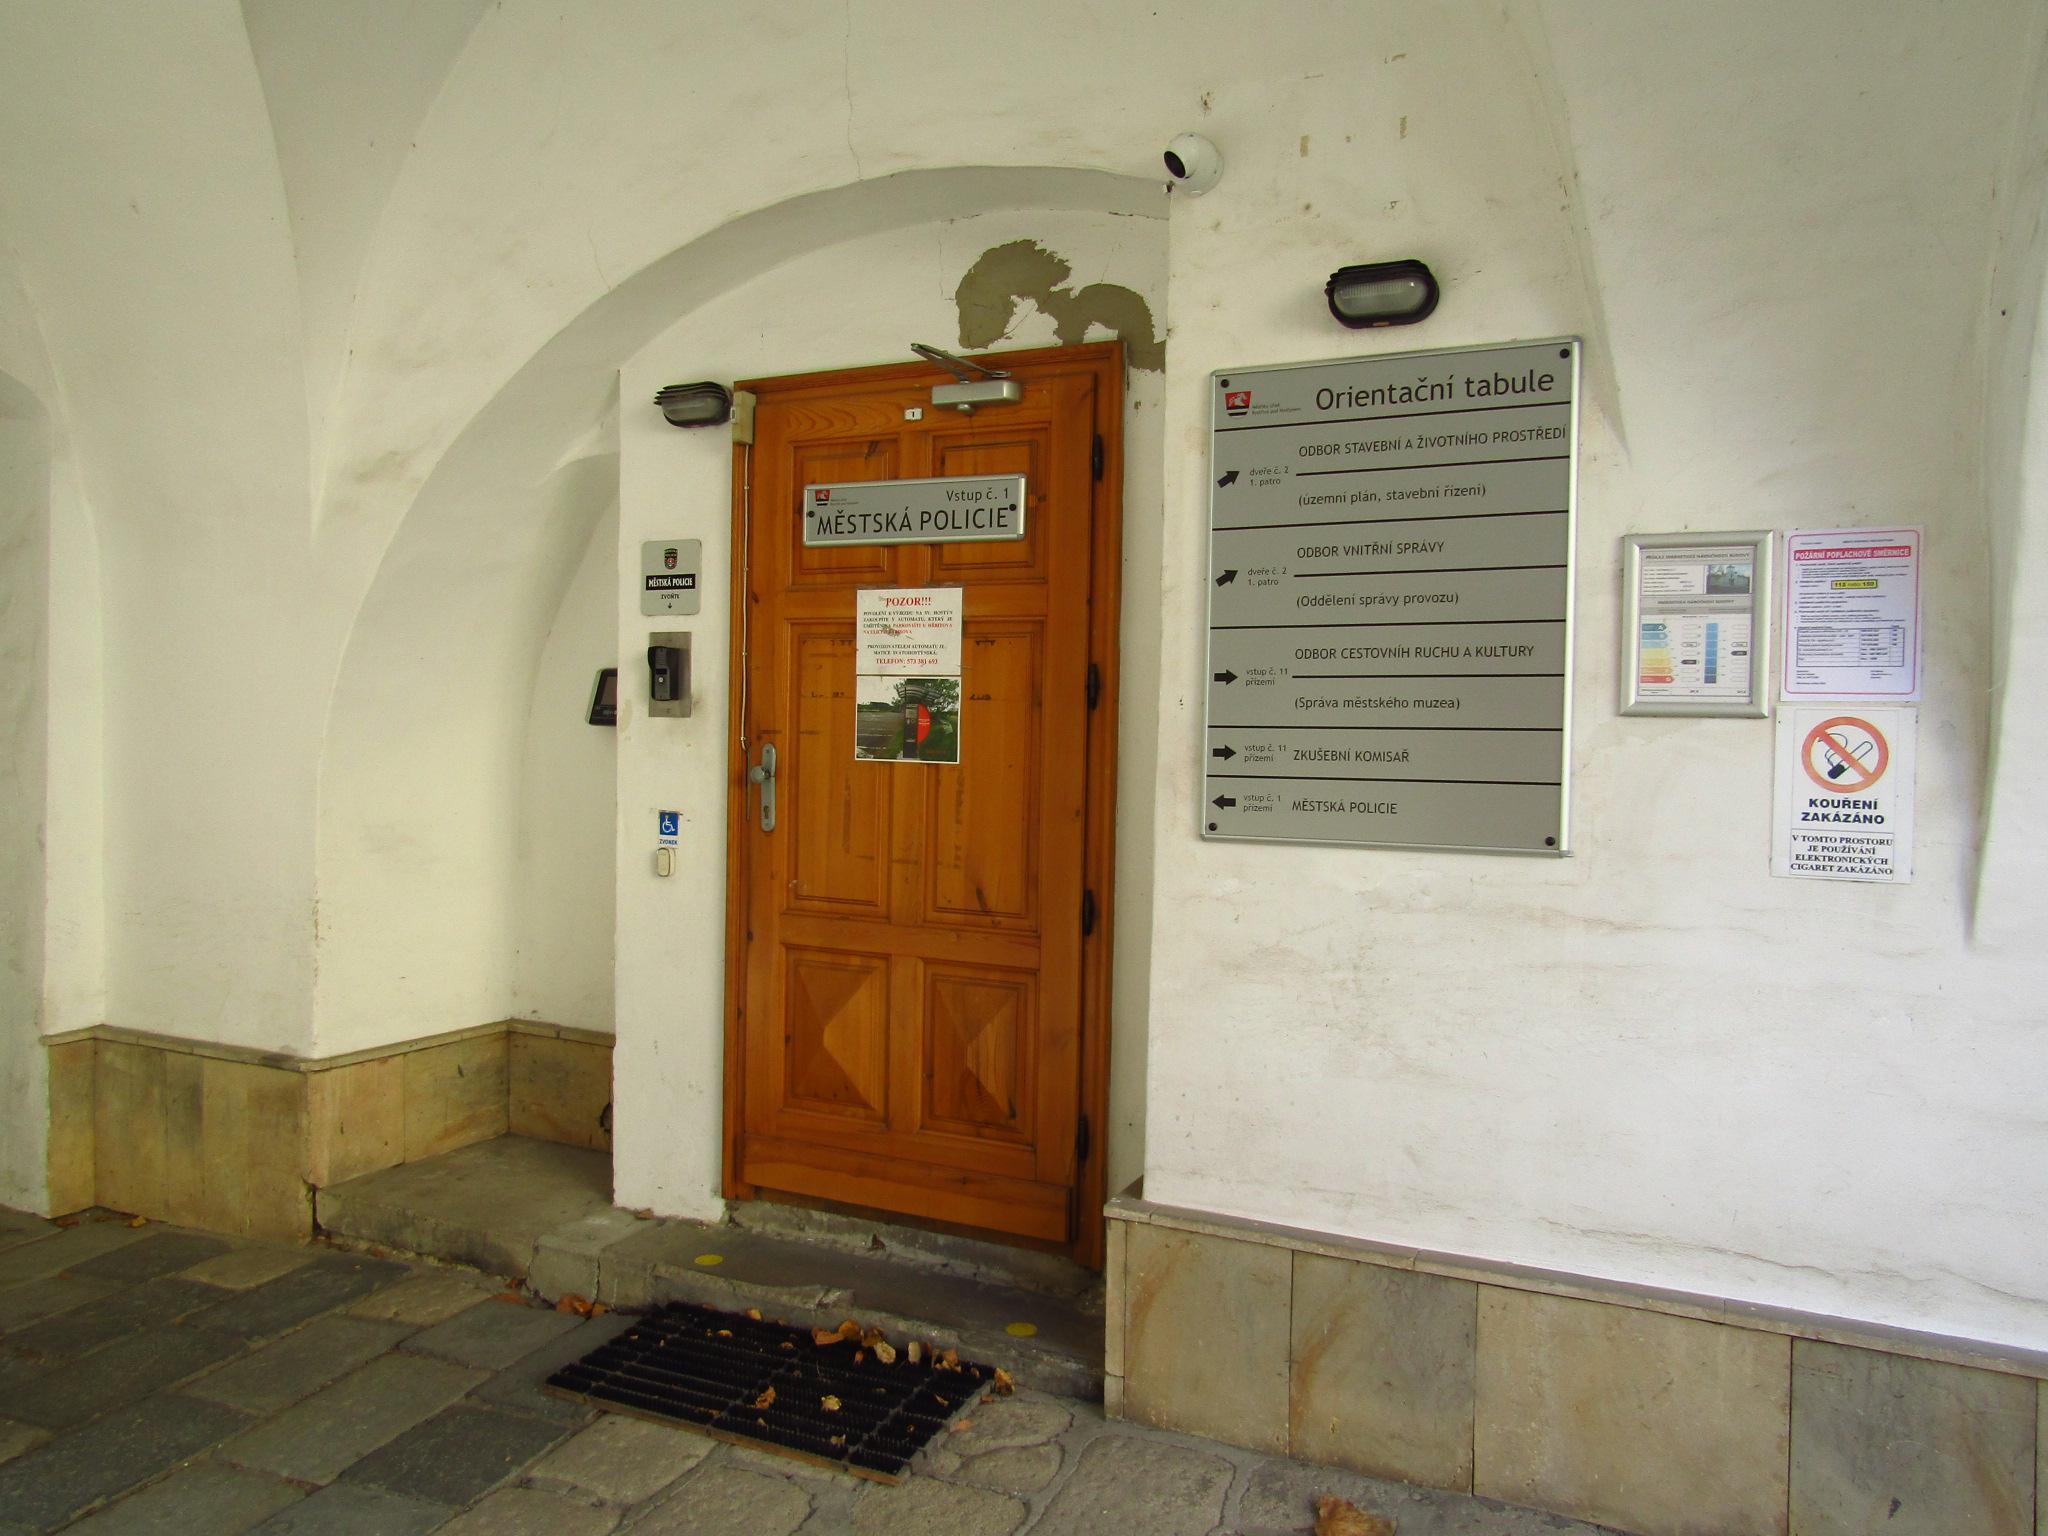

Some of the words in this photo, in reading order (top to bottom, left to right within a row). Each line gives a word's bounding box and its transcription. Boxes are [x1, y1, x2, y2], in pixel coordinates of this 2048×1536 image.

[1316, 374, 1454, 411] Orientační
[1465, 369, 1555, 398] tabule
[1299, 442, 1340, 458] ODBOR
[1345, 436, 1401, 455] STAVEBNÍ
[1405, 438, 1413, 450] A
[1416, 431, 1488, 450] ŽIVOTNÍHO
[1492, 425, 1566, 444] PROSTŘEDÍ
[1249, 467, 1271, 477] dveře
[1273, 466, 1281, 475] č.
[1284, 466, 1289, 474] 2
[1250, 478, 1256, 487] 1.
[1259, 476, 1281, 488] patro
[946, 489, 982, 503] Vstup
[986, 487, 998, 500] č.
[1004, 488, 1008, 499] 1
[1298, 490, 1347, 508] (územní
[1350, 488, 1381, 506] plán,
[1386, 485, 1439, 501] stavební
[1443, 483, 1486, 498] řízení)
[817, 506, 912, 535] MĚSTSKÁ
[920, 507, 1009, 531] POLICIE
[1297, 545, 1339, 559] ODBOR
[1343, 541, 1393, 557] VNITŘNÍ
[1396, 539, 1445, 555] SPRÁVY
[1247, 567, 1269, 577] dveře
[1271, 567, 1279, 576] č.
[1282, 567, 1287, 575] 2
[648, 577, 671, 587] MĚSTSKÁ
[672, 578, 693, 586] POLICIE
[1248, 578, 1255, 587] 1.
[1257, 577, 1279, 588] patro
[886, 597, 931, 607] POZOR!!!
[1296, 593, 1356, 609] (Oddělení
[1359, 592, 1399, 608] správy
[1403, 591, 1459, 607] provozu)
[1295, 646, 1337, 660] ODBOR
[1340, 643, 1411, 660] CESTOVNÍH
[1415, 646, 1459, 659] RUCHU
[1463, 646, 1472, 658] A
[1475, 645, 1535, 657] KULTURY
[1245, 668, 1266, 678] vstup
[1280, 667, 1288, 676] 11
[1245, 676, 1276, 687] přízemí
[1294, 696, 1338, 710] (Správa
[1342, 696, 1409, 709] městského
[1413, 697, 1460, 710] muzea)
[1244, 744, 1264, 754] vstup
[1278, 744, 1287, 752] 11
[1293, 746, 1350, 762] ZKUŠEBNÍ
[1354, 749, 1410, 763] KOMISAŘ
[1244, 753, 1274, 763] přízemí
[1243, 794, 1264, 804] vstup
[1808, 797, 1878, 810] KOUŘENÍ
[1243, 803, 1273, 813] přízemí
[1292, 798, 1345, 813] MĚSTSKÁ
[1349, 801, 1398, 815] POLICIE
[1801, 810, 1885, 825] ZAKÁZÁNO
[1792, 834, 1799, 842] V
[1801, 835, 1837, 844] TOMTO
[1839, 837, 1893, 847] PROSTORU
[1807, 844, 1819, 852] JE
[1821, 844, 1876, 855] POUŽÍVÁNÍ
[1795, 853, 1888, 865] ELEKTRONICKÝCH
[1790, 863, 1834, 872] CIGARET
[1837, 863, 1893, 875] ZAKÁZÁNO
